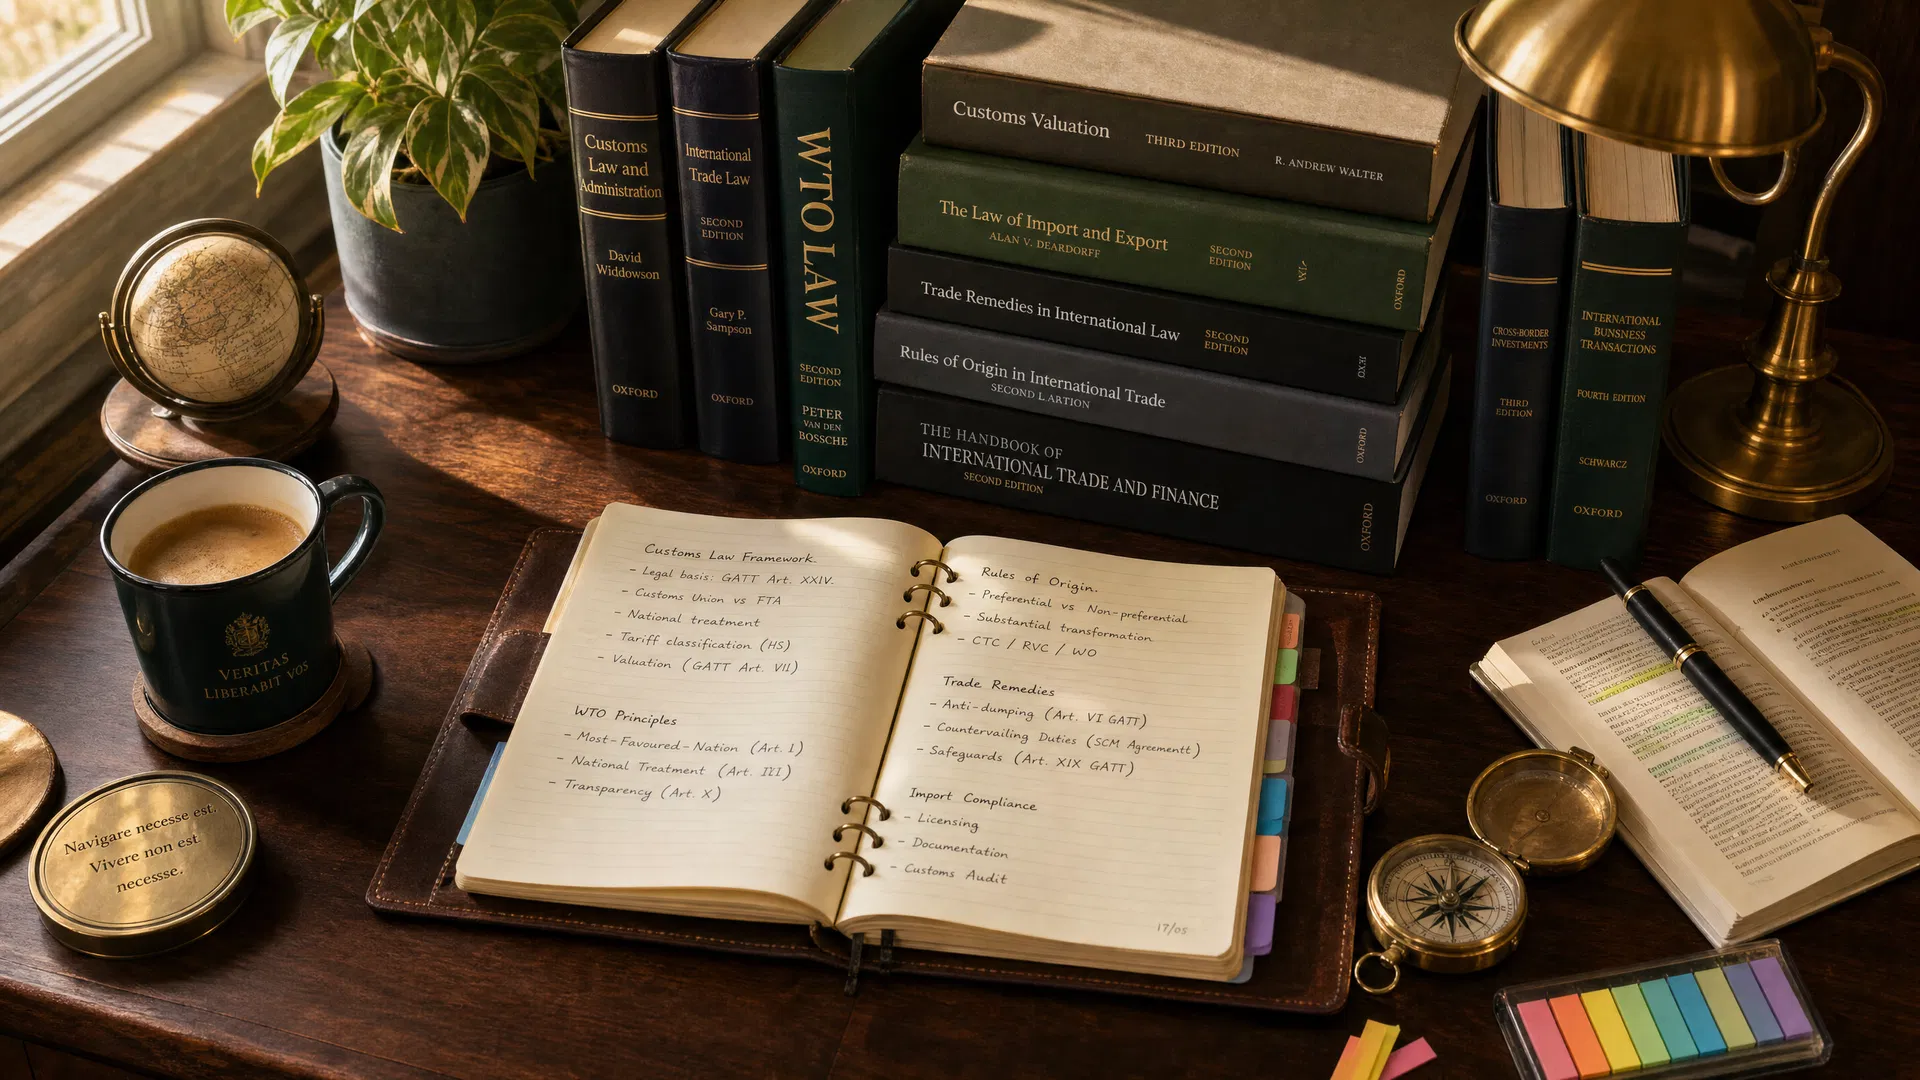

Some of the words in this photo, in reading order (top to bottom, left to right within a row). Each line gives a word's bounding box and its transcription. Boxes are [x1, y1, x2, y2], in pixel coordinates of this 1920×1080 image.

[953, 100, 1026, 126] Customs
[1031, 112, 1110, 139] Valuation
[584, 134, 648, 153] Customs
[685, 143, 751, 162] International
[1145, 133, 1186, 150] THIRD
[1189, 140, 1240, 158] EDITION
[589, 156, 619, 175] Law
[622, 161, 648, 177] and
[1275, 155, 1285, 166] R.
[1288, 158, 1336, 173] ANDREW
[1339, 166, 1384, 182] WALTER
[689, 167, 722, 185] Trade
[725, 172, 750, 186] Law
[797, 127, 835, 233] WTO
[579, 179, 662, 199] Administration
[700, 216, 743, 229] SECOND
[939, 199, 968, 218] The
[972, 205, 1003, 223] Law
[1007, 210, 1023, 227] of
[1026, 214, 1079, 238] Import
[1082, 222, 1110, 241] and
[1115, 229, 1168, 252] Export
[701, 229, 744, 241] EDITION
[989, 232, 1020, 246] ALAN
[1023, 236, 1033, 247] V.
[1037, 239, 1100, 258] DEARDORFF
[1209, 244, 1253, 259] SECOND
[608, 249, 641, 264] David
[1209, 256, 1252, 271] EDITION
[596, 263, 659, 280] Widdowson
[803, 240, 839, 335] LAW
[1394, 269, 1406, 311] OXFORD
[709, 307, 734, 321] Gary
[736, 308, 747, 320] P.
[921, 281, 962, 301] Trade
[966, 290, 1033, 314] Remedies
[1037, 303, 1051, 317] in
[1055, 306, 1146, 335] International
[1150, 324, 1180, 341] Law
[1582, 310, 1661, 326] INTERNATIONAL
[706, 321, 752, 336] Sampson
[1205, 329, 1249, 344] SECOND
[1493, 326, 1549, 338] CROSS-BORDER
[1594, 326, 1646, 340] BUNSNESS
[1204, 341, 1249, 356] EDITION
[1491, 338, 1548, 350] INVESTMENTS
[1580, 339, 1657, 354] TRANSACTIONS
[800, 363, 841, 376] SECOND
[900, 344, 939, 364] Rules
[943, 354, 959, 368] of
[962, 357, 1008, 379] Origin
[1012, 367, 1026, 381] in
[1030, 370, 1121, 400] International
[1125, 389, 1166, 408] Trade
[800, 375, 841, 387] EDITION
[612, 384, 658, 399] OXFORD
[711, 393, 754, 406] OXFORD
[991, 383, 1035, 399] SECOND
[1577, 389, 1609, 401] FOURTH
[1612, 393, 1646, 403] EDITION
[1500, 398, 1529, 407] THIRD
[802, 405, 843, 420] PETER
[1496, 408, 1533, 418] EDITION
[803, 420, 821, 430] VAN
[823, 422, 841, 431] DEN
[798, 431, 848, 446] BOSSCHE
[920, 422, 951, 439] THE
[957, 428, 1040, 455] HANDBOOK
[1044, 446, 1063, 460] OF
[1356, 427, 1368, 464] OXFORD
[802, 465, 847, 478] OXFORD
[1579, 456, 1628, 469] SCHWARCZ
[922, 442, 1053, 480] INTERNATIONAL
[1056, 467, 1109, 490] TRADE
[1113, 478, 1148, 497] AND
[1151, 483, 1220, 511] FINANCE
[963, 471, 1002, 486] SECOND
[1004, 479, 1044, 495] EDITION
[1485, 494, 1528, 505] OXFORD
[1574, 505, 1623, 518] OXFORD
[1360, 503, 1374, 551] OXFORD
[644, 543, 701, 559] Customs
[709, 551, 735, 561] Law
[643, 566, 673, 581] Legal
[680, 570, 713, 582] basis:
[722, 574, 760, 583] GATT
[767, 576, 792, 584] Art.
[800, 576, 834, 585] XXIV.
[981, 567, 1015, 580] Rules
[1025, 573, 1040, 584] of
[1049, 576, 1098, 594] Origin.
[635, 588, 684, 601] Customs
[692, 594, 724, 604] Union
[734, 597, 746, 605] vs
[756, 596, 781, 605] FTA
[982, 589, 1052, 608] Preferential
[1061, 603, 1074, 611] vs
[1087, 604, 1188, 624] Non-preferential
[628, 609, 682, 624] National
[691, 616, 761, 627] treatment
[977, 612, 1051, 631] Substantial
[1060, 623, 1152, 642] transformation
[620, 632, 660, 646] Tariff
[666, 637, 752, 650] classification
[759, 638, 791, 652] (HS)
[972, 636, 1000, 647] CTC
[1022, 641, 1048, 653] RVC
[1072, 648, 1097, 657] WO
[218, 652, 289, 681] VERITAS
[613, 654, 672, 670] Valuation
[682, 657, 732, 673] (GATT
[738, 662, 764, 673] Art.
[204, 675, 281, 699] LIBERABIT
[287, 660, 309, 679] VOS
[943, 675, 982, 689] Trade
[991, 679, 1055, 697] Remedies
[574, 705, 606, 718] WTO
[615, 710, 677, 728] Principles
[942, 699, 1035, 722] Anti-dumping
[1044, 706, 1078, 722] (Art.
[1108, 714, 1147, 730] GATT)
[577, 731, 738, 752] Most-Favoured-Nation
[750, 740, 782, 756] (Art.
[937, 722, 1029, 744] Countervailing
[1038, 732, 1077, 746] Duties
[1087, 734, 1120, 749] (SCM
[571, 755, 630, 771] National
[639, 761, 706, 776] Treatment
[718, 763, 753, 779] (Art.
[929, 745, 1002, 763] Safeguards
[1013, 750, 1048, 767] (Art.
[1056, 757, 1081, 769] XIX
[1090, 761, 1135, 778] GATT)
[565, 779, 653, 802] Transparency
[661, 784, 695, 800] (Art.
[701, 786, 721, 803] X)
[909, 787, 953, 803] Import
[964, 792, 1037, 812] Compliance
[64, 828, 132, 855] Navigare
[136, 812, 189, 834] necesse
[193, 804, 217, 818] est.
[917, 813, 980, 834] Licensing
[89, 853, 140, 874] Vivere
[145, 843, 173, 859] non
[178, 834, 201, 848] est.
[912, 837, 1009, 860] Documentation
[116, 866, 184, 894] necessse.
[904, 863, 955, 879] Customs
[965, 870, 1008, 885] Audit
[1157, 922, 1188, 936] 17/05
